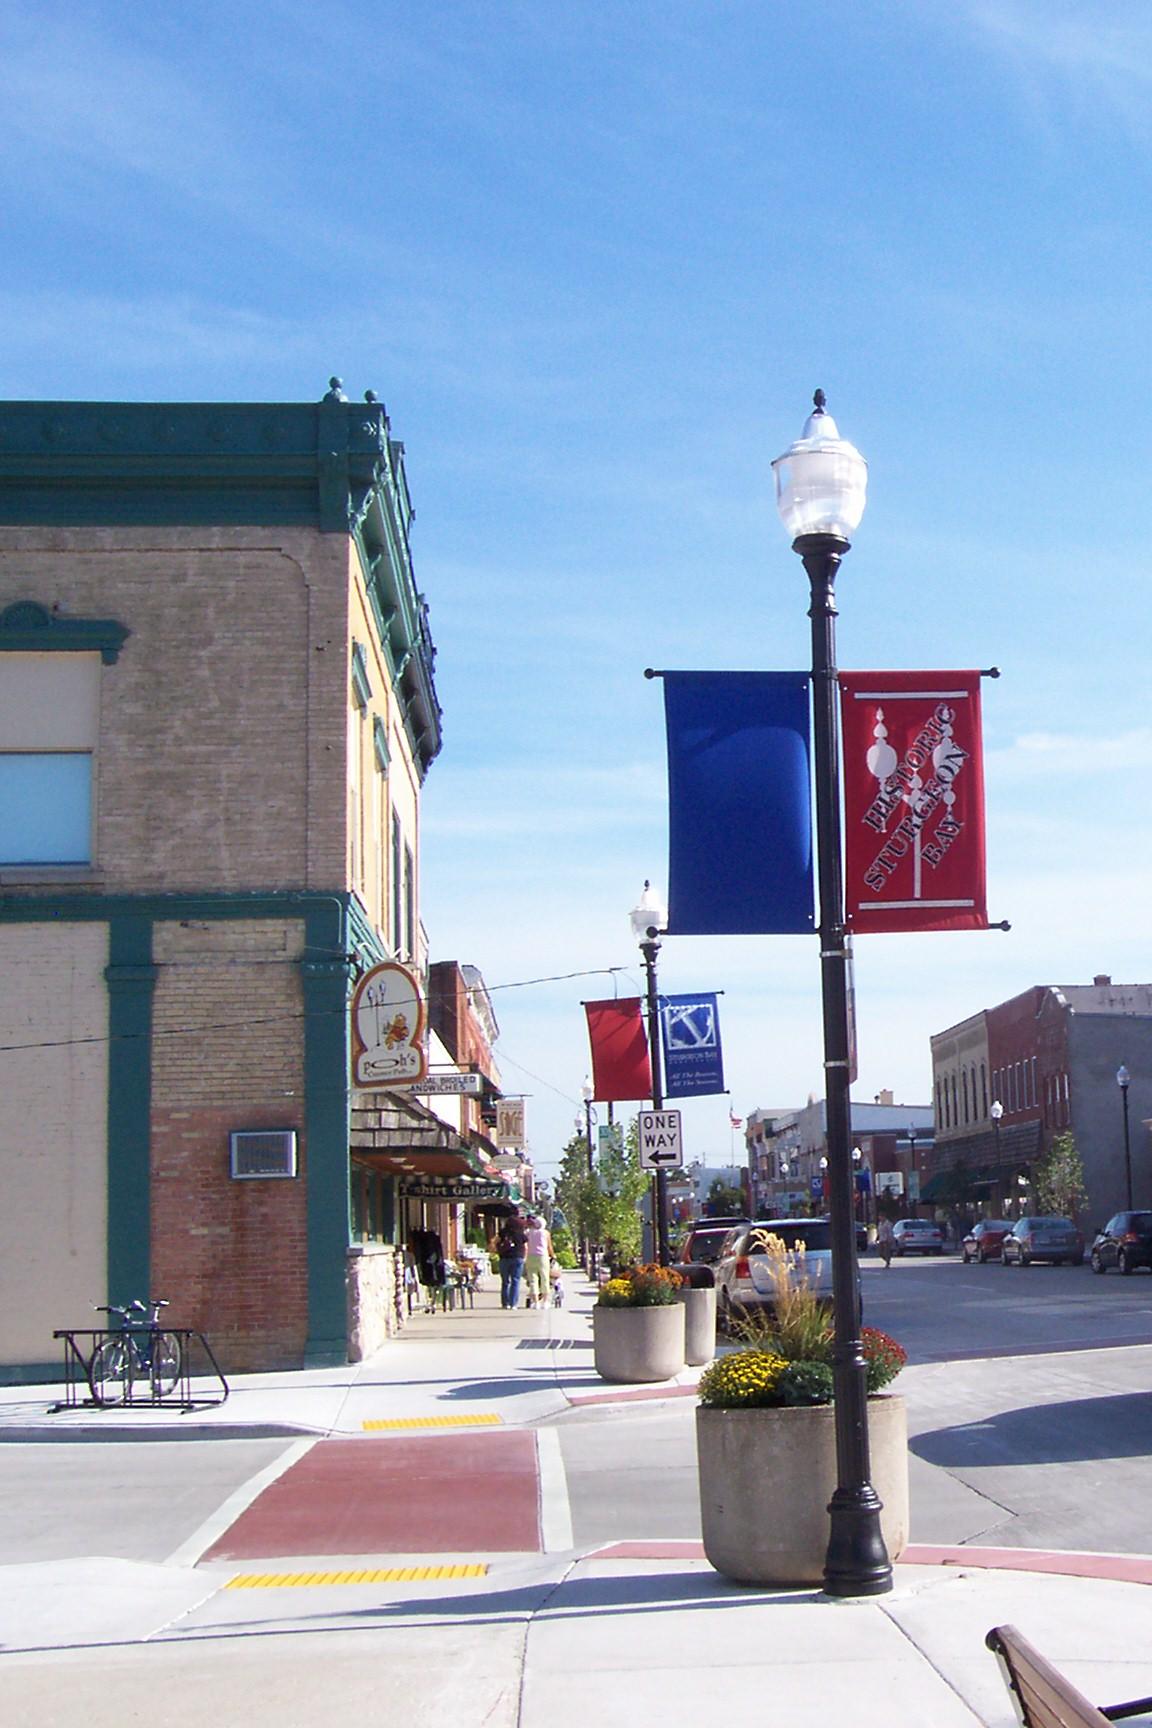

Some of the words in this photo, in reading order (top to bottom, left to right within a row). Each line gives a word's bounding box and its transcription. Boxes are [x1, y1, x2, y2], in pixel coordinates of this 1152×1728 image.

[862, 703, 956, 833] HISTORIC
[864, 741, 969, 892] STURGEON
[920, 811, 964, 869] BAY
[410, 1083, 465, 1092] ANDWICHES
[643, 1115, 677, 1129] ONE
[644, 1133, 677, 1147] WAY
